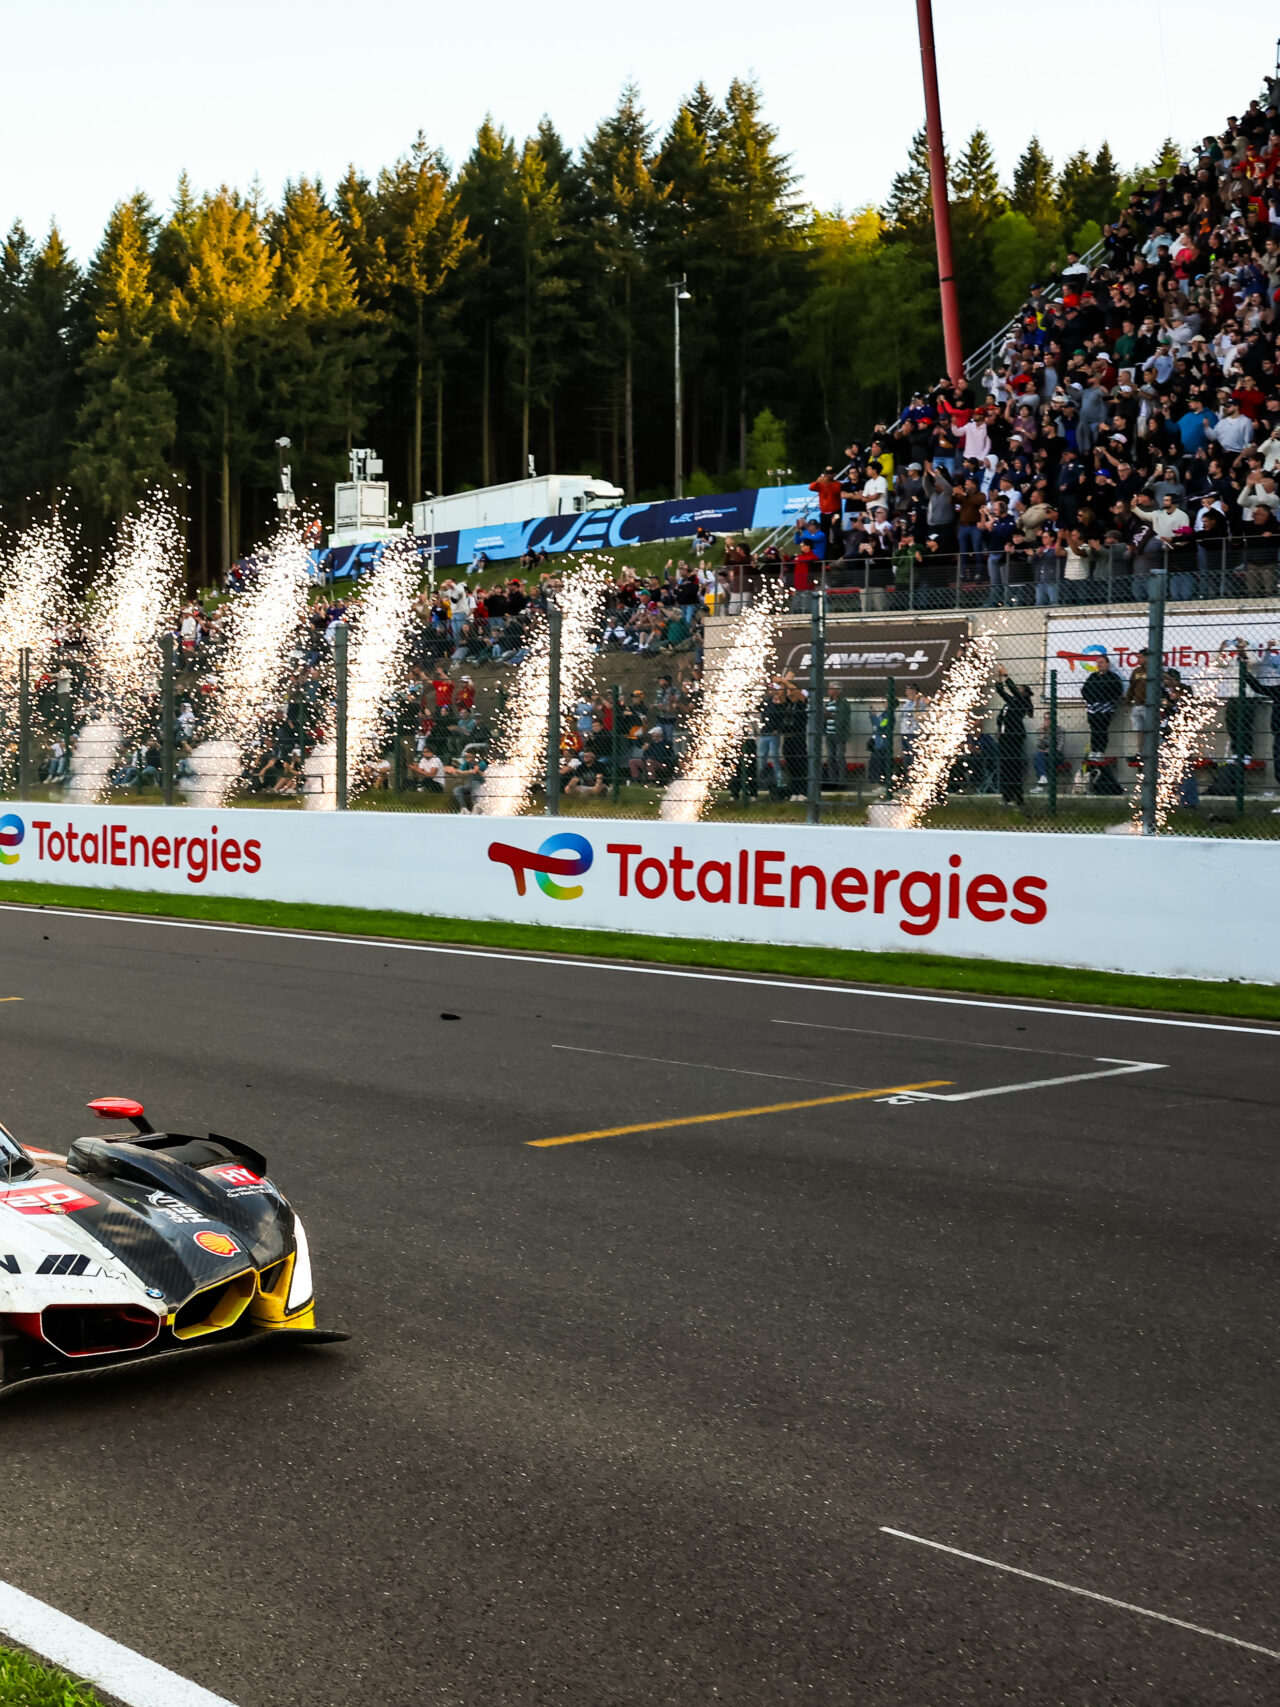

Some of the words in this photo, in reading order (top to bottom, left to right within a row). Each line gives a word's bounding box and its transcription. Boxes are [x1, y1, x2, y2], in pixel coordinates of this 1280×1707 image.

[522, 504, 652, 551] WEC
[32, 821, 262, 883] TotalEnergies
[607, 843, 1048, 936] TotalEnergies
[217, 1168, 257, 1183] HY
[1, 1189, 84, 1208] 20
[145, 1190, 212, 1224] HELIX
